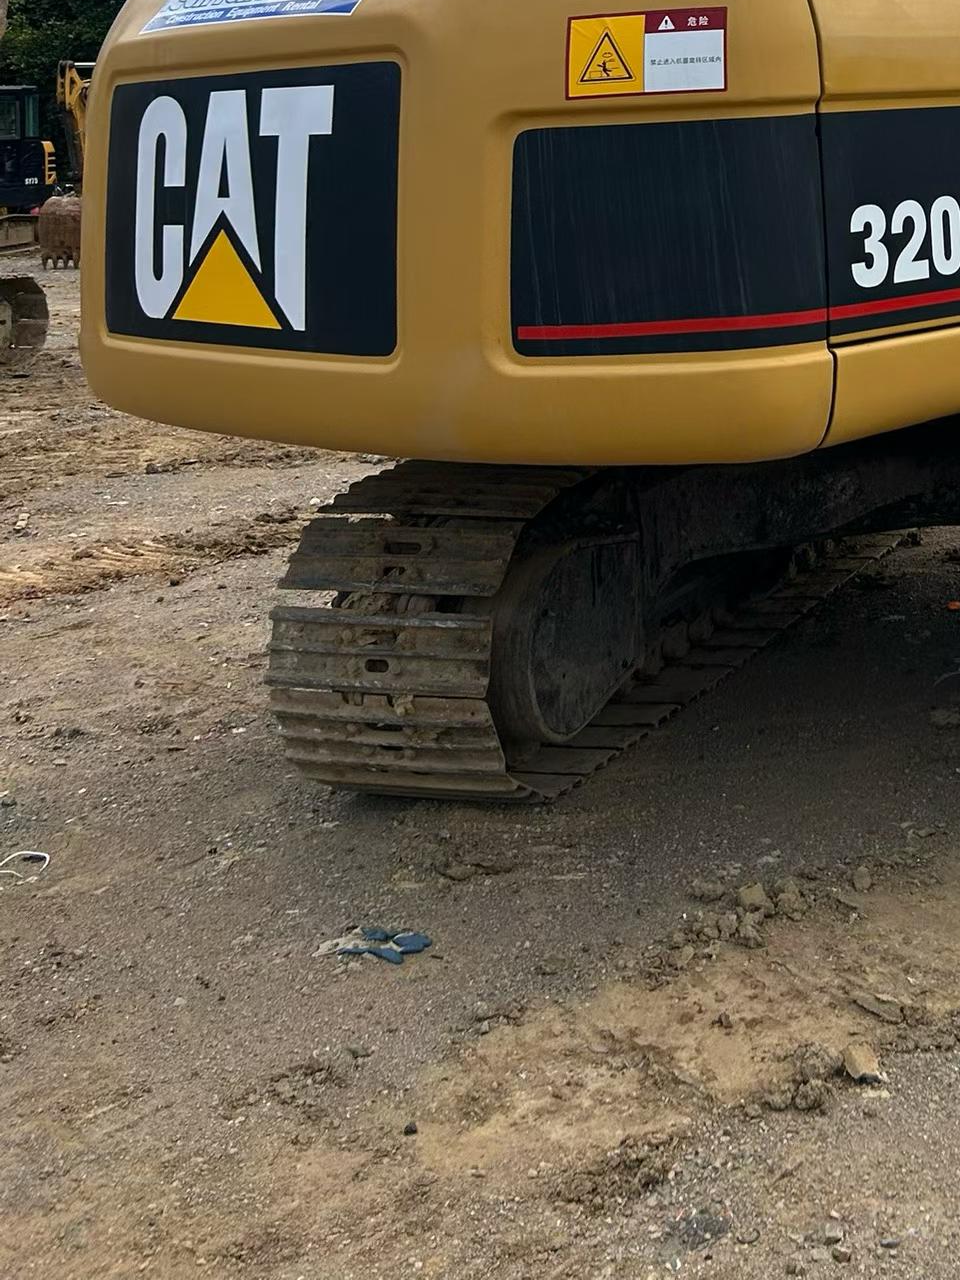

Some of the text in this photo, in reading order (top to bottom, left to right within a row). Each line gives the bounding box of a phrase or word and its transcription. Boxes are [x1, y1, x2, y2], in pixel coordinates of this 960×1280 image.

[165, 0, 322, 25] Construction Equipment Rental
[687, 16, 709, 27] 危险
[135, 85, 335, 331] CAT
